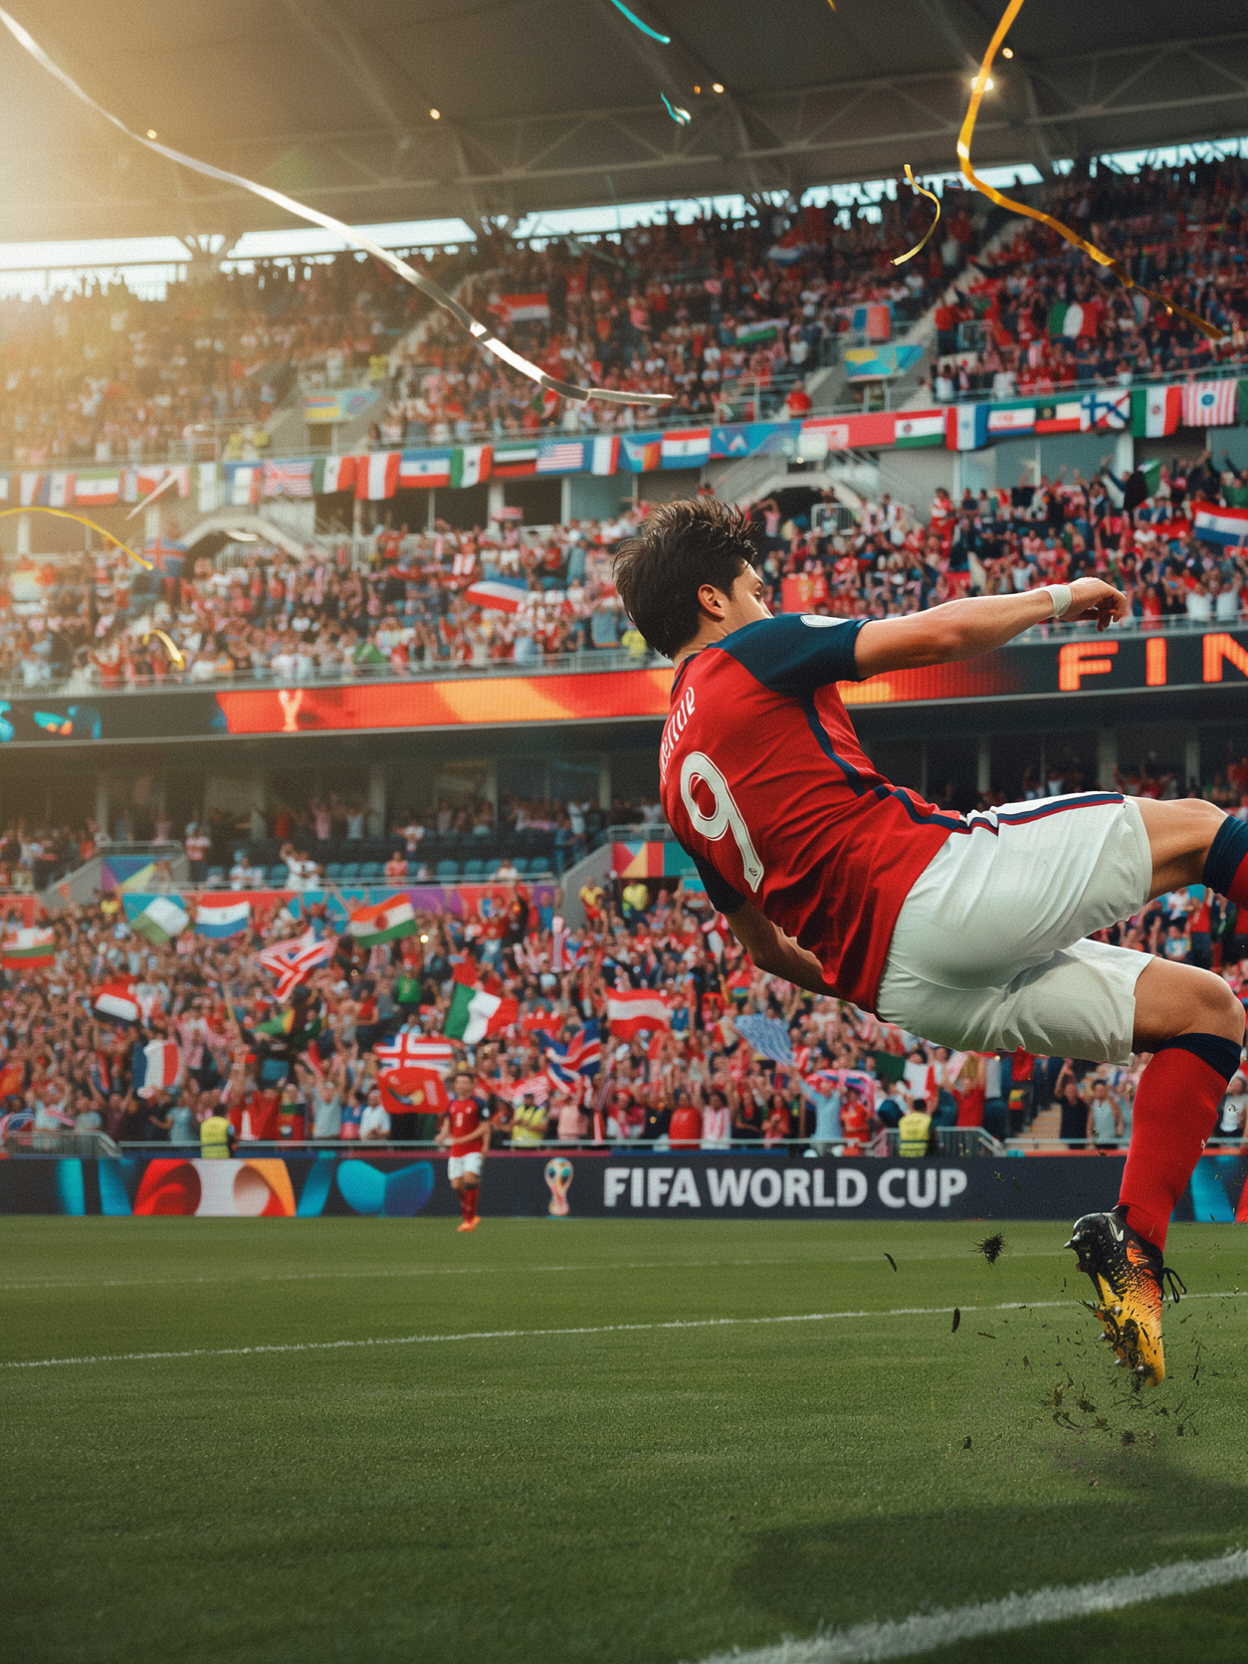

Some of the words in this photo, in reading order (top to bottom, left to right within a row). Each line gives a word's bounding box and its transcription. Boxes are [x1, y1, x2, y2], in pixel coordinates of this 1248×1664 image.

[680, 751, 764, 893] 9
[603, 1167, 701, 1207] FIFA
[706, 1168, 868, 1208] WORLD
[877, 1168, 968, 1208] CUP
